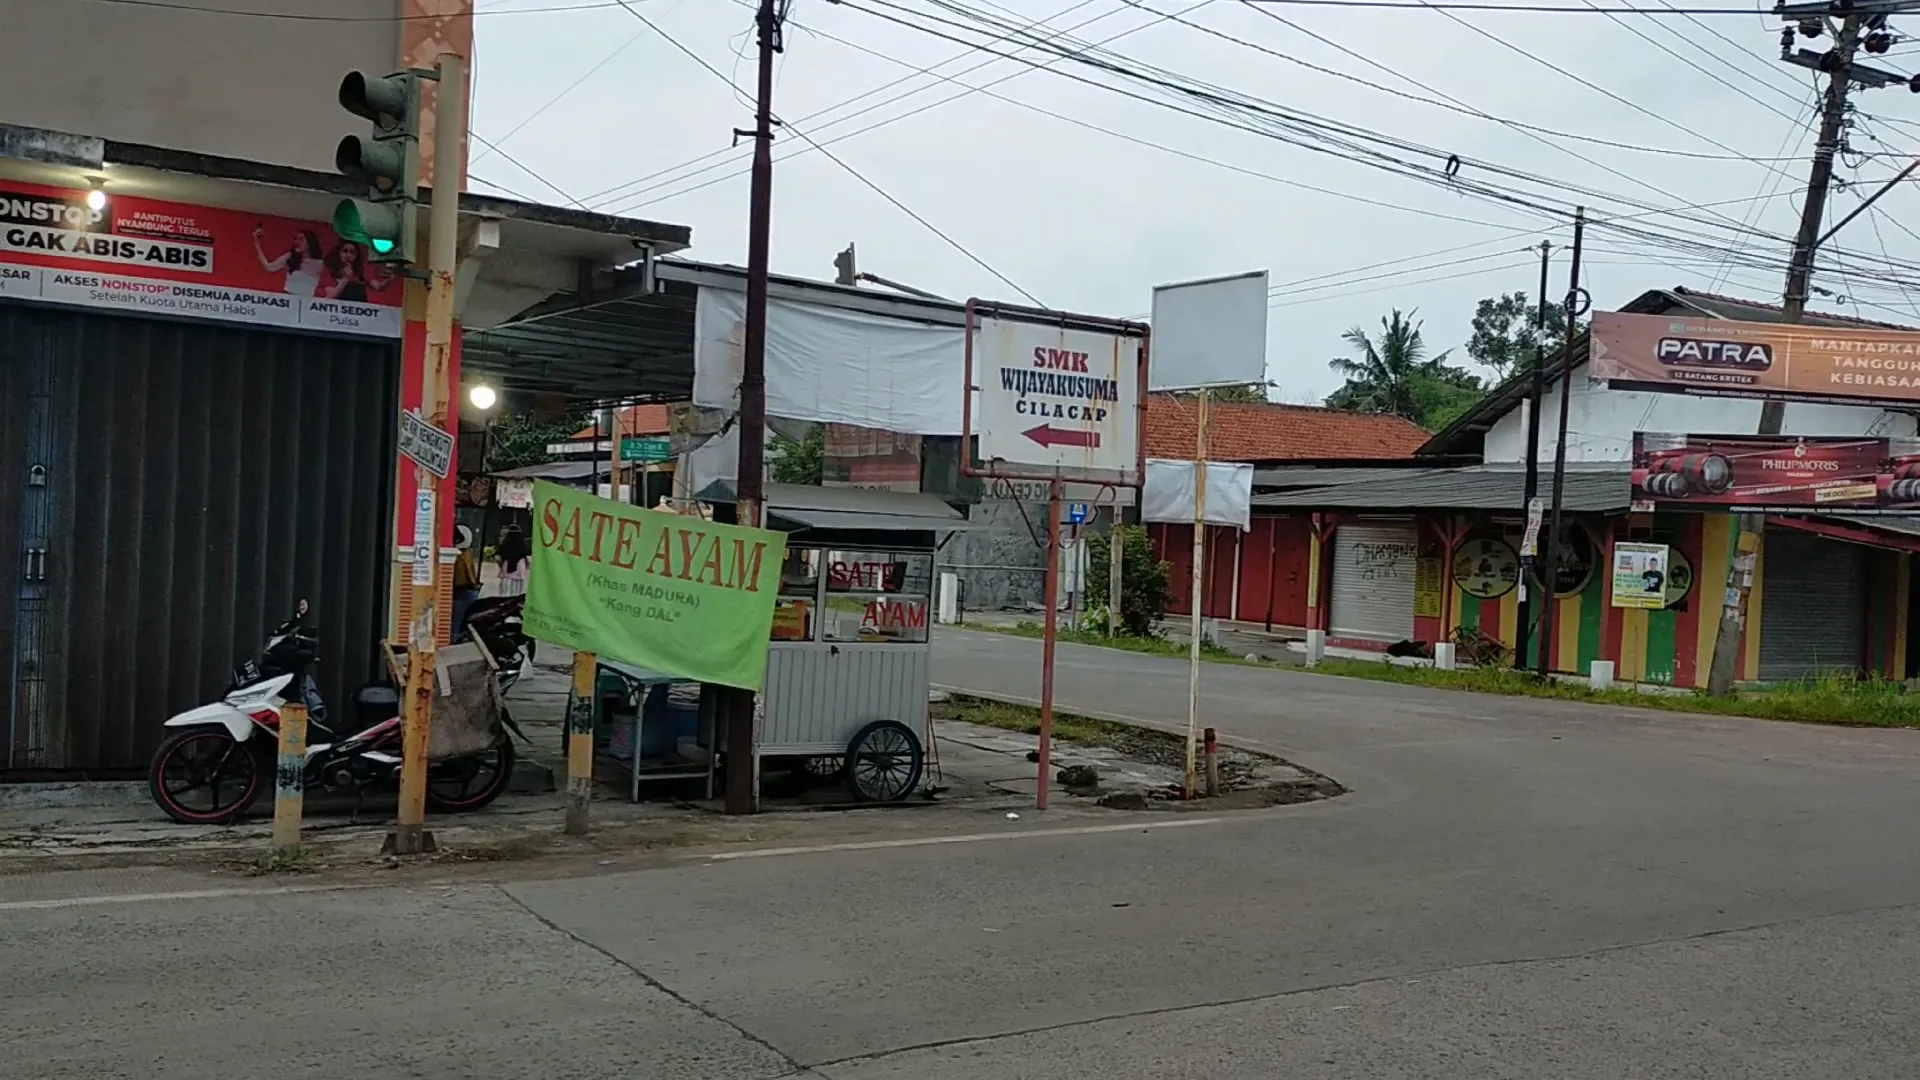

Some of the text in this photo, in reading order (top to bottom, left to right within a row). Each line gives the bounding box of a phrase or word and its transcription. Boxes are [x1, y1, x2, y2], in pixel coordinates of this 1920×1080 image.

[117, 218, 174, 233] NYAMBUNG
[177, 225, 210, 237] TERUS
[133, 211, 195, 227] #ANTIPUTUS
[6, 228, 208, 267] GAK ABIS-ABIS
[53, 273, 99, 287] AKSES
[234, 292, 290, 309] APLIKASI
[89, 290, 256, 317] Setelah Kuota Utama Habis
[310, 302, 380, 318] ANTI SEDOT
[329, 315, 359, 327] Pulsa
[1033, 346, 1089, 373] SMK
[1659, 339, 1770, 364] PATRA
[1000, 367, 1118, 402] WIJAYAKUSUMA
[1684, 372, 1719, 381] BATANG
[1719, 375, 1753, 384] KRETEK
[1015, 399, 1107, 422] CILACAP
[541, 498, 768, 592] SATE AYAM
[830, 560, 896, 591] SATE
[586, 572, 700, 609] (Khas MADURA)
[862, 600, 926, 628] AYAM
